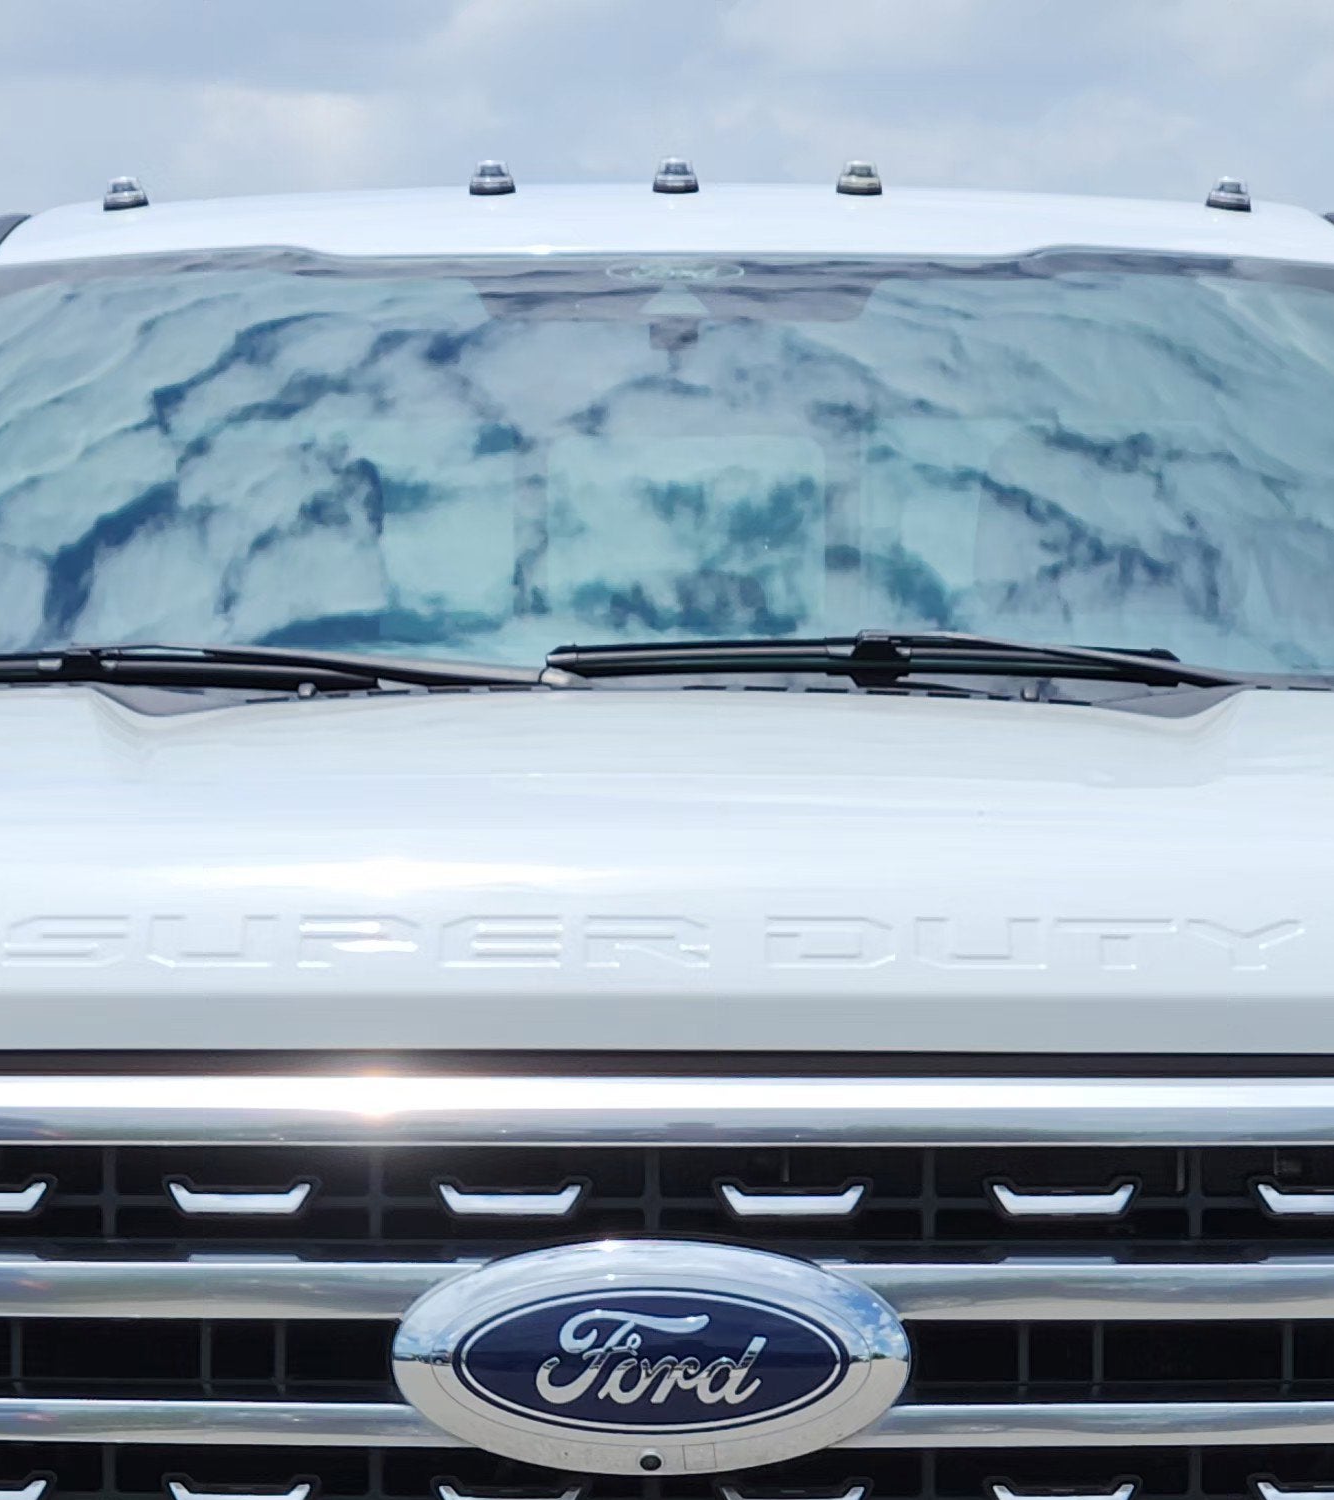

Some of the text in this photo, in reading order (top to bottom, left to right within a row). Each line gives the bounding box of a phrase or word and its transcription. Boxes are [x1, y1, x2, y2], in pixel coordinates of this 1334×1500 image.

[2, 912, 1307, 971] SUPER DUTY
[535, 1308, 768, 1405] Ford
